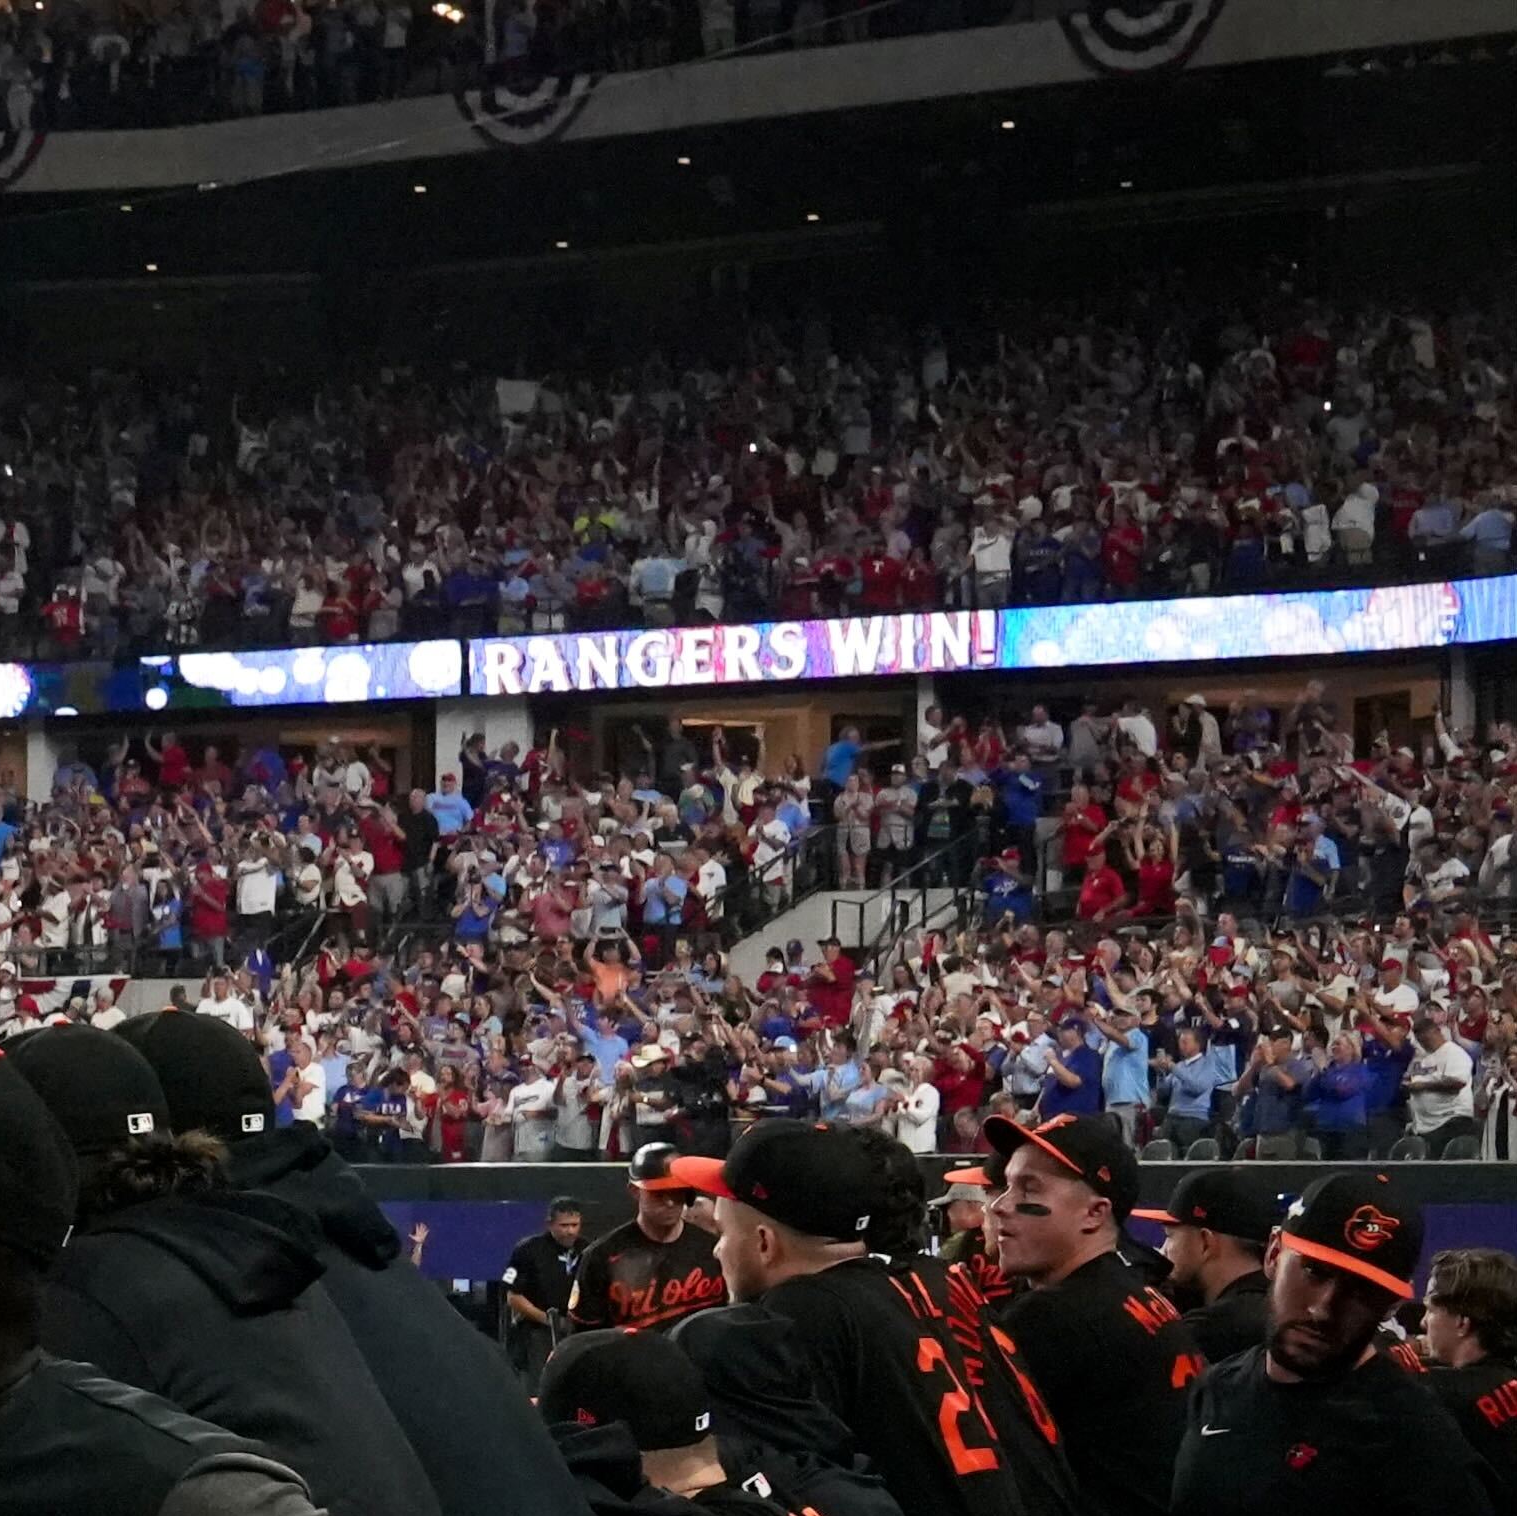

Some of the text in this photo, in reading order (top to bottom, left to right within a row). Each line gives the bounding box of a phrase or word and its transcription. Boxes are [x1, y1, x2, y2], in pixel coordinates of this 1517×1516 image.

[483, 608, 998, 697] RANGERS WIN!
[609, 1266, 724, 1320] Orioles
